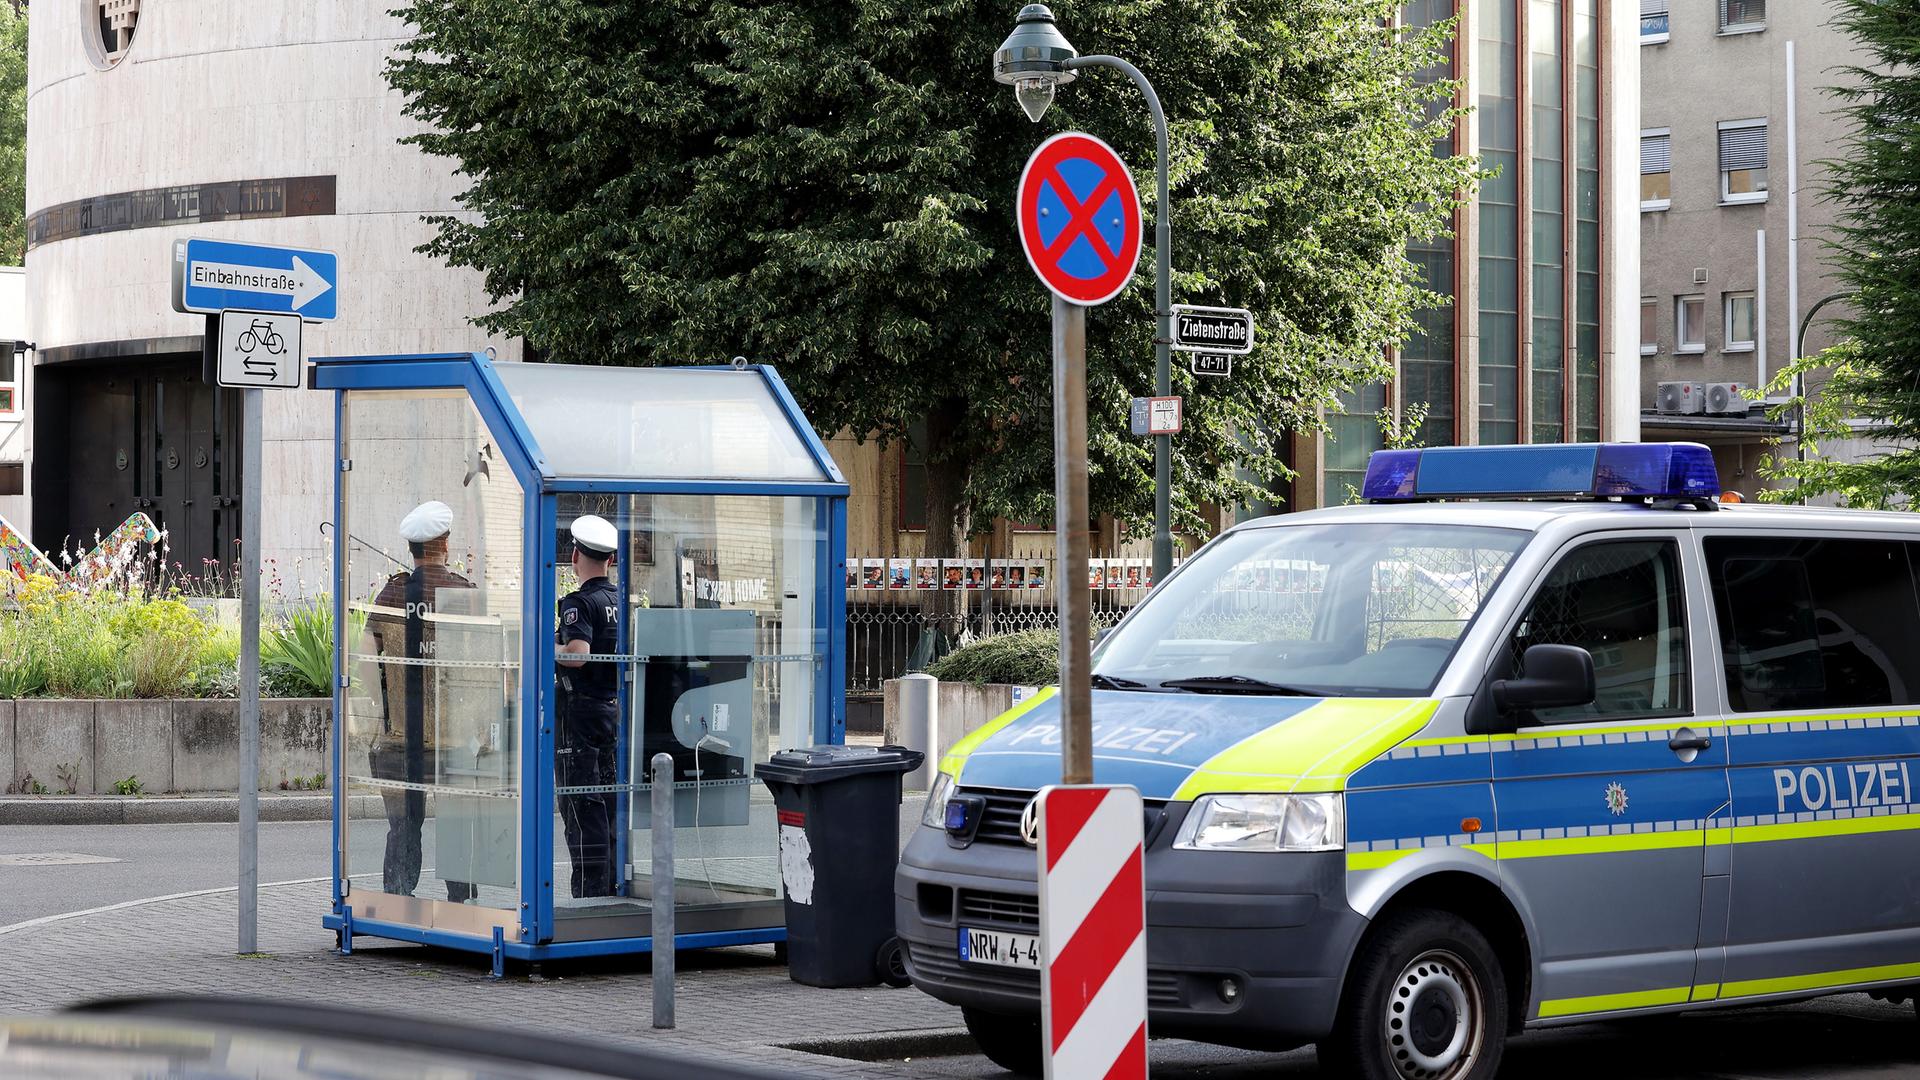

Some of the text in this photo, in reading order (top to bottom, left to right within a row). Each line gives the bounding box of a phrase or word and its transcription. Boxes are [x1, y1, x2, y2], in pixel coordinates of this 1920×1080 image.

[195, 266, 295, 290] Einbahnstraße
[1181, 317, 1246, 340] Zietenstraße
[1200, 356, 1224, 370] 47-71
[734, 577, 769, 602] HOME
[1773, 762, 1911, 813] POLIZEI
[969, 932, 1040, 966] NRW 4-4
